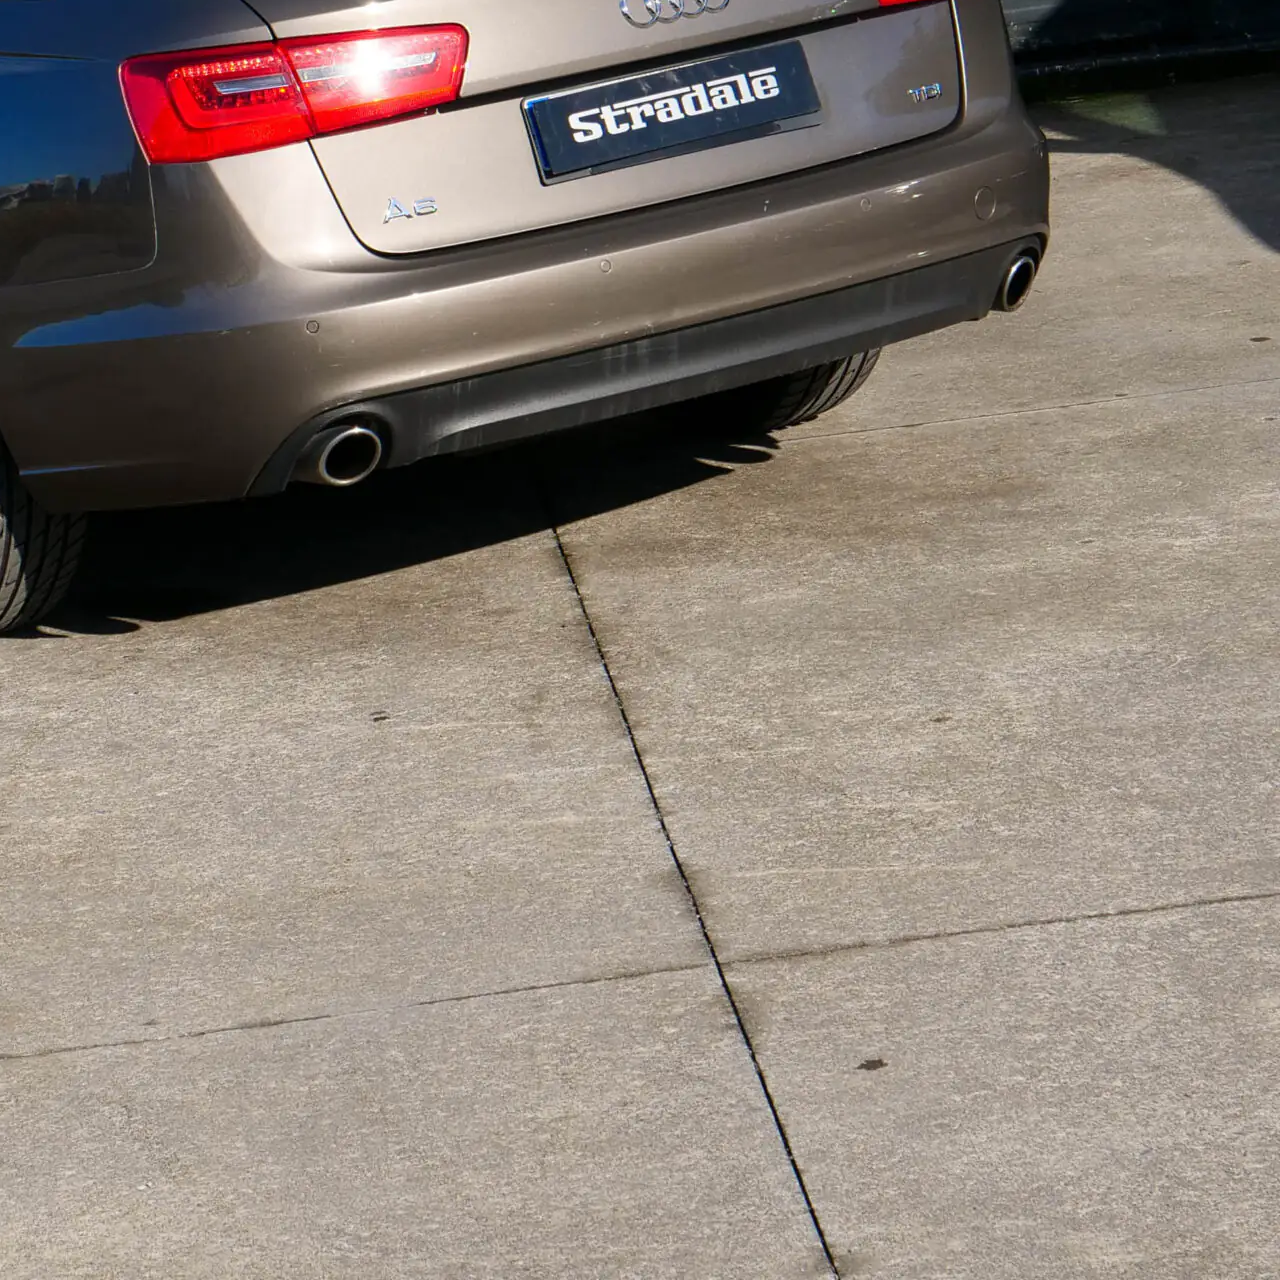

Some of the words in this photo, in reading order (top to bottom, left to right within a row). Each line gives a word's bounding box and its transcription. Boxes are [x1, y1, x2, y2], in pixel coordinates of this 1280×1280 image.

[568, 66, 780, 143] Stradale
[906, 82, 942, 103] TDI
[382, 196, 438, 224] A6
